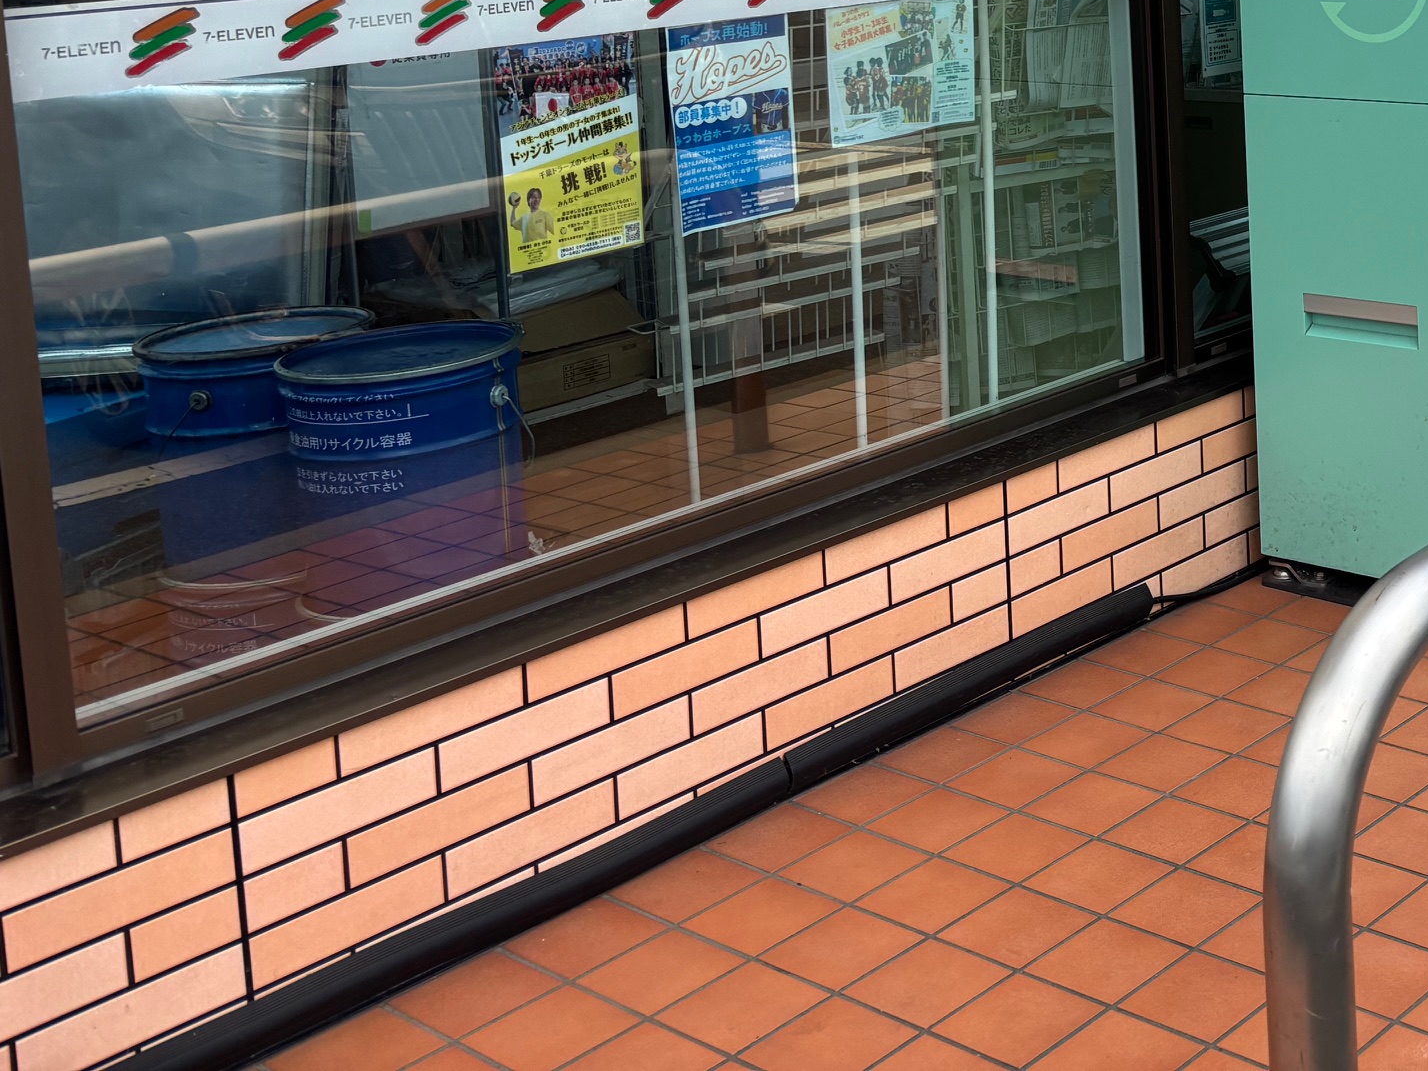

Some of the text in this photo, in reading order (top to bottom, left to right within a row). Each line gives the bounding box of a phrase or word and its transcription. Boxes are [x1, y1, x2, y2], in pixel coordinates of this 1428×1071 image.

[679, 21, 769, 46] ホープス再始動!
[671, 40, 788, 107] Hopes
